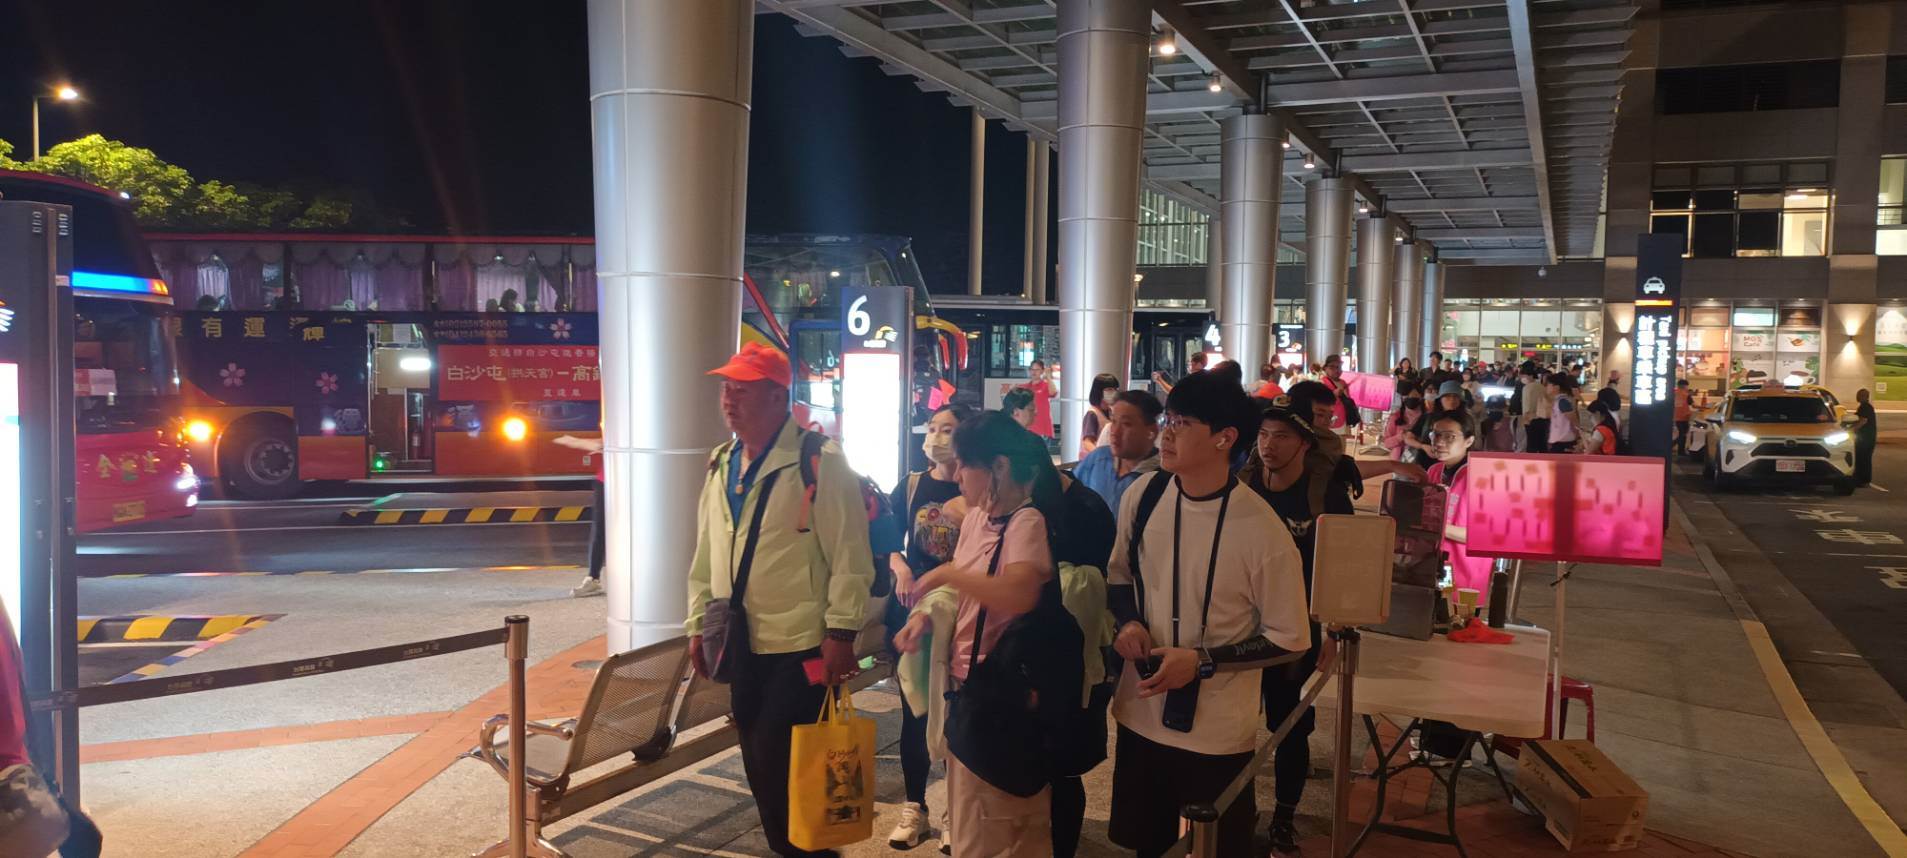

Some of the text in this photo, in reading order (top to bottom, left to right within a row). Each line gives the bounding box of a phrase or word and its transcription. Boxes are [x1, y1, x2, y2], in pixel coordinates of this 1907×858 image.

[847, 295, 871, 336] 6
[1204, 324, 1221, 346] 4
[1278, 330, 1291, 348] 3
